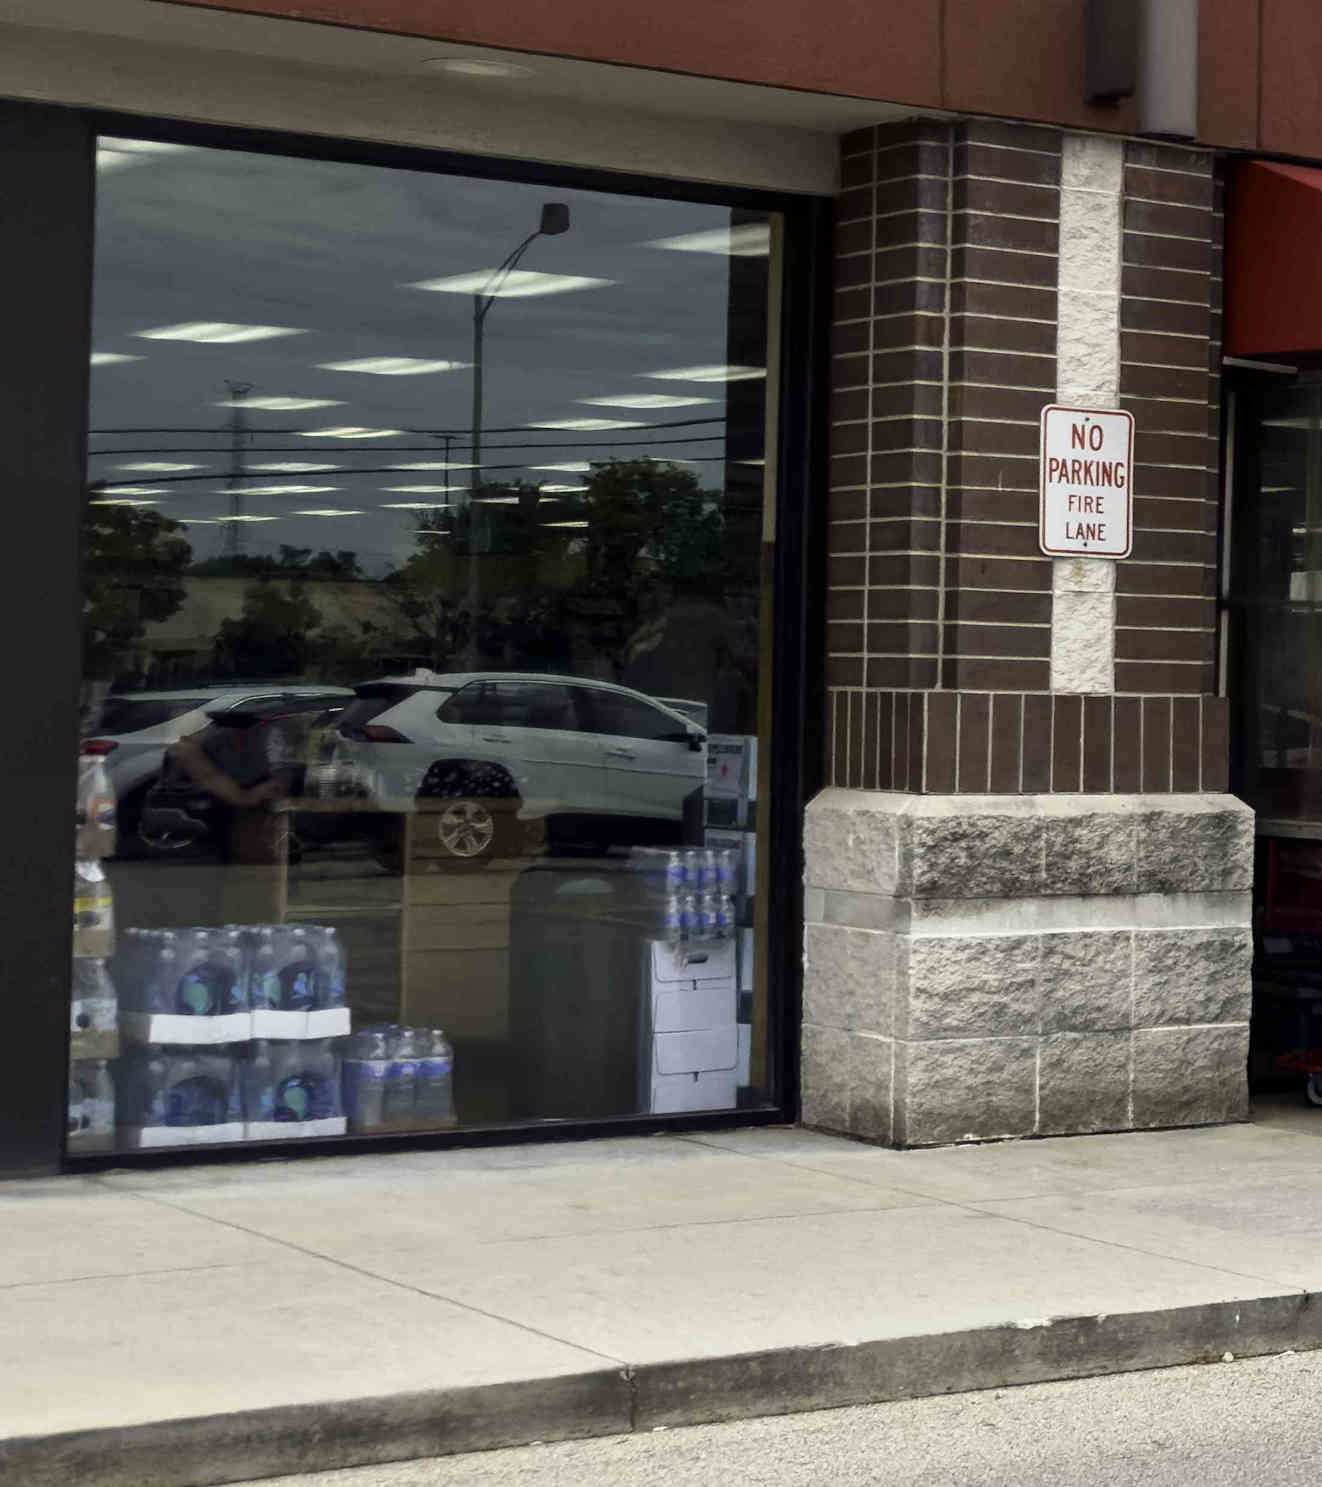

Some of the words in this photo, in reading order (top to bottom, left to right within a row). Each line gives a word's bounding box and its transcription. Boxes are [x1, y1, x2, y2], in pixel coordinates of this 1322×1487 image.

[1071, 423, 1105, 452] NO
[1048, 457, 1126, 489] PARKING
[1068, 494, 1105, 514] FIRE
[1065, 521, 1107, 542] LANE
